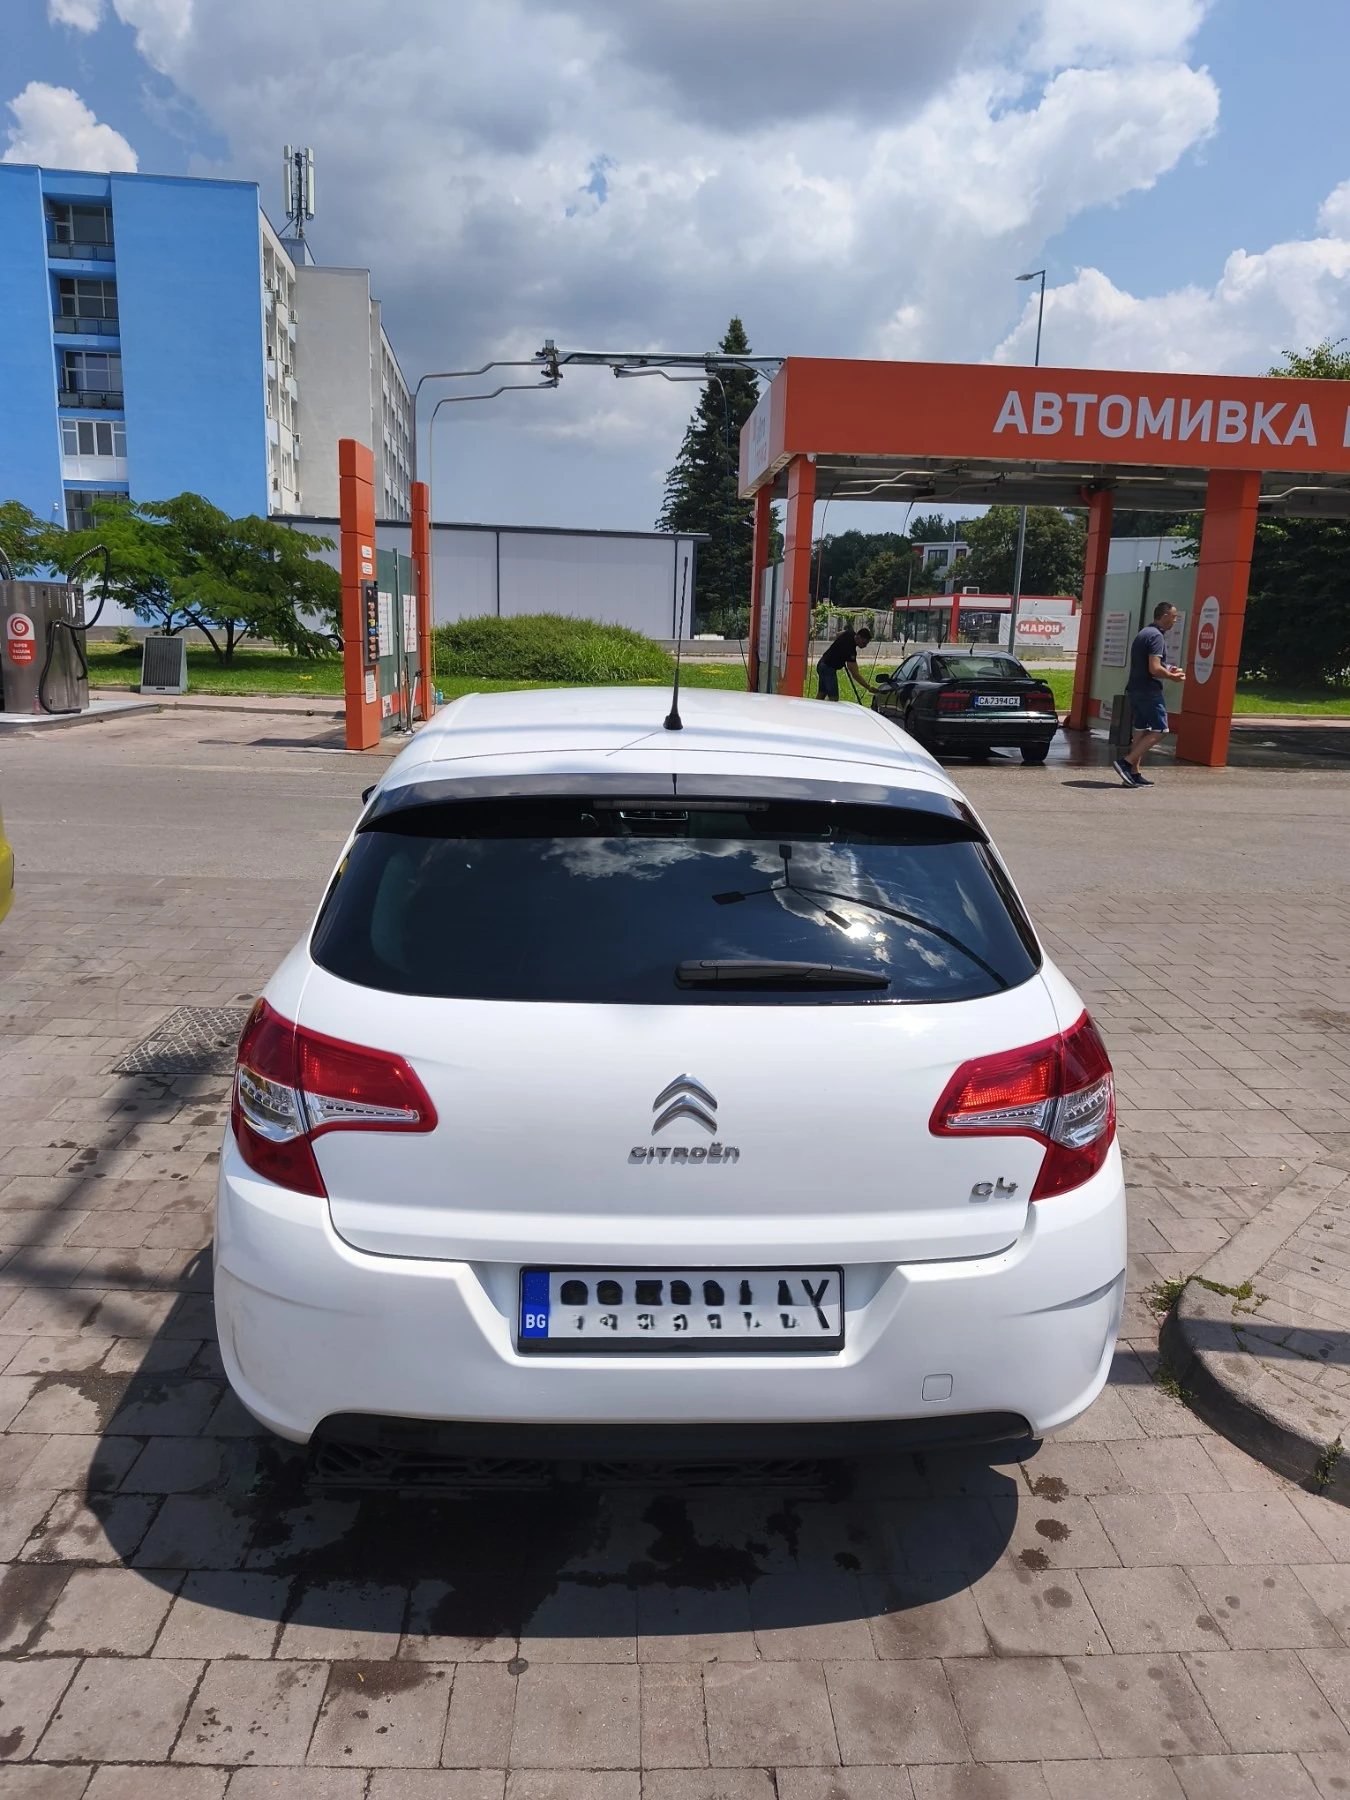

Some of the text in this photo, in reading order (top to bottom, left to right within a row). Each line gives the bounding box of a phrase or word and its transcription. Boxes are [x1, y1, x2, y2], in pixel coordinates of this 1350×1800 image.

[993, 390, 1317, 447] АВТОМИВКА
[1019, 623, 1060, 633] МАРОН
[971, 1176, 1019, 1196] C4
[525, 1313, 547, 1329] BG
